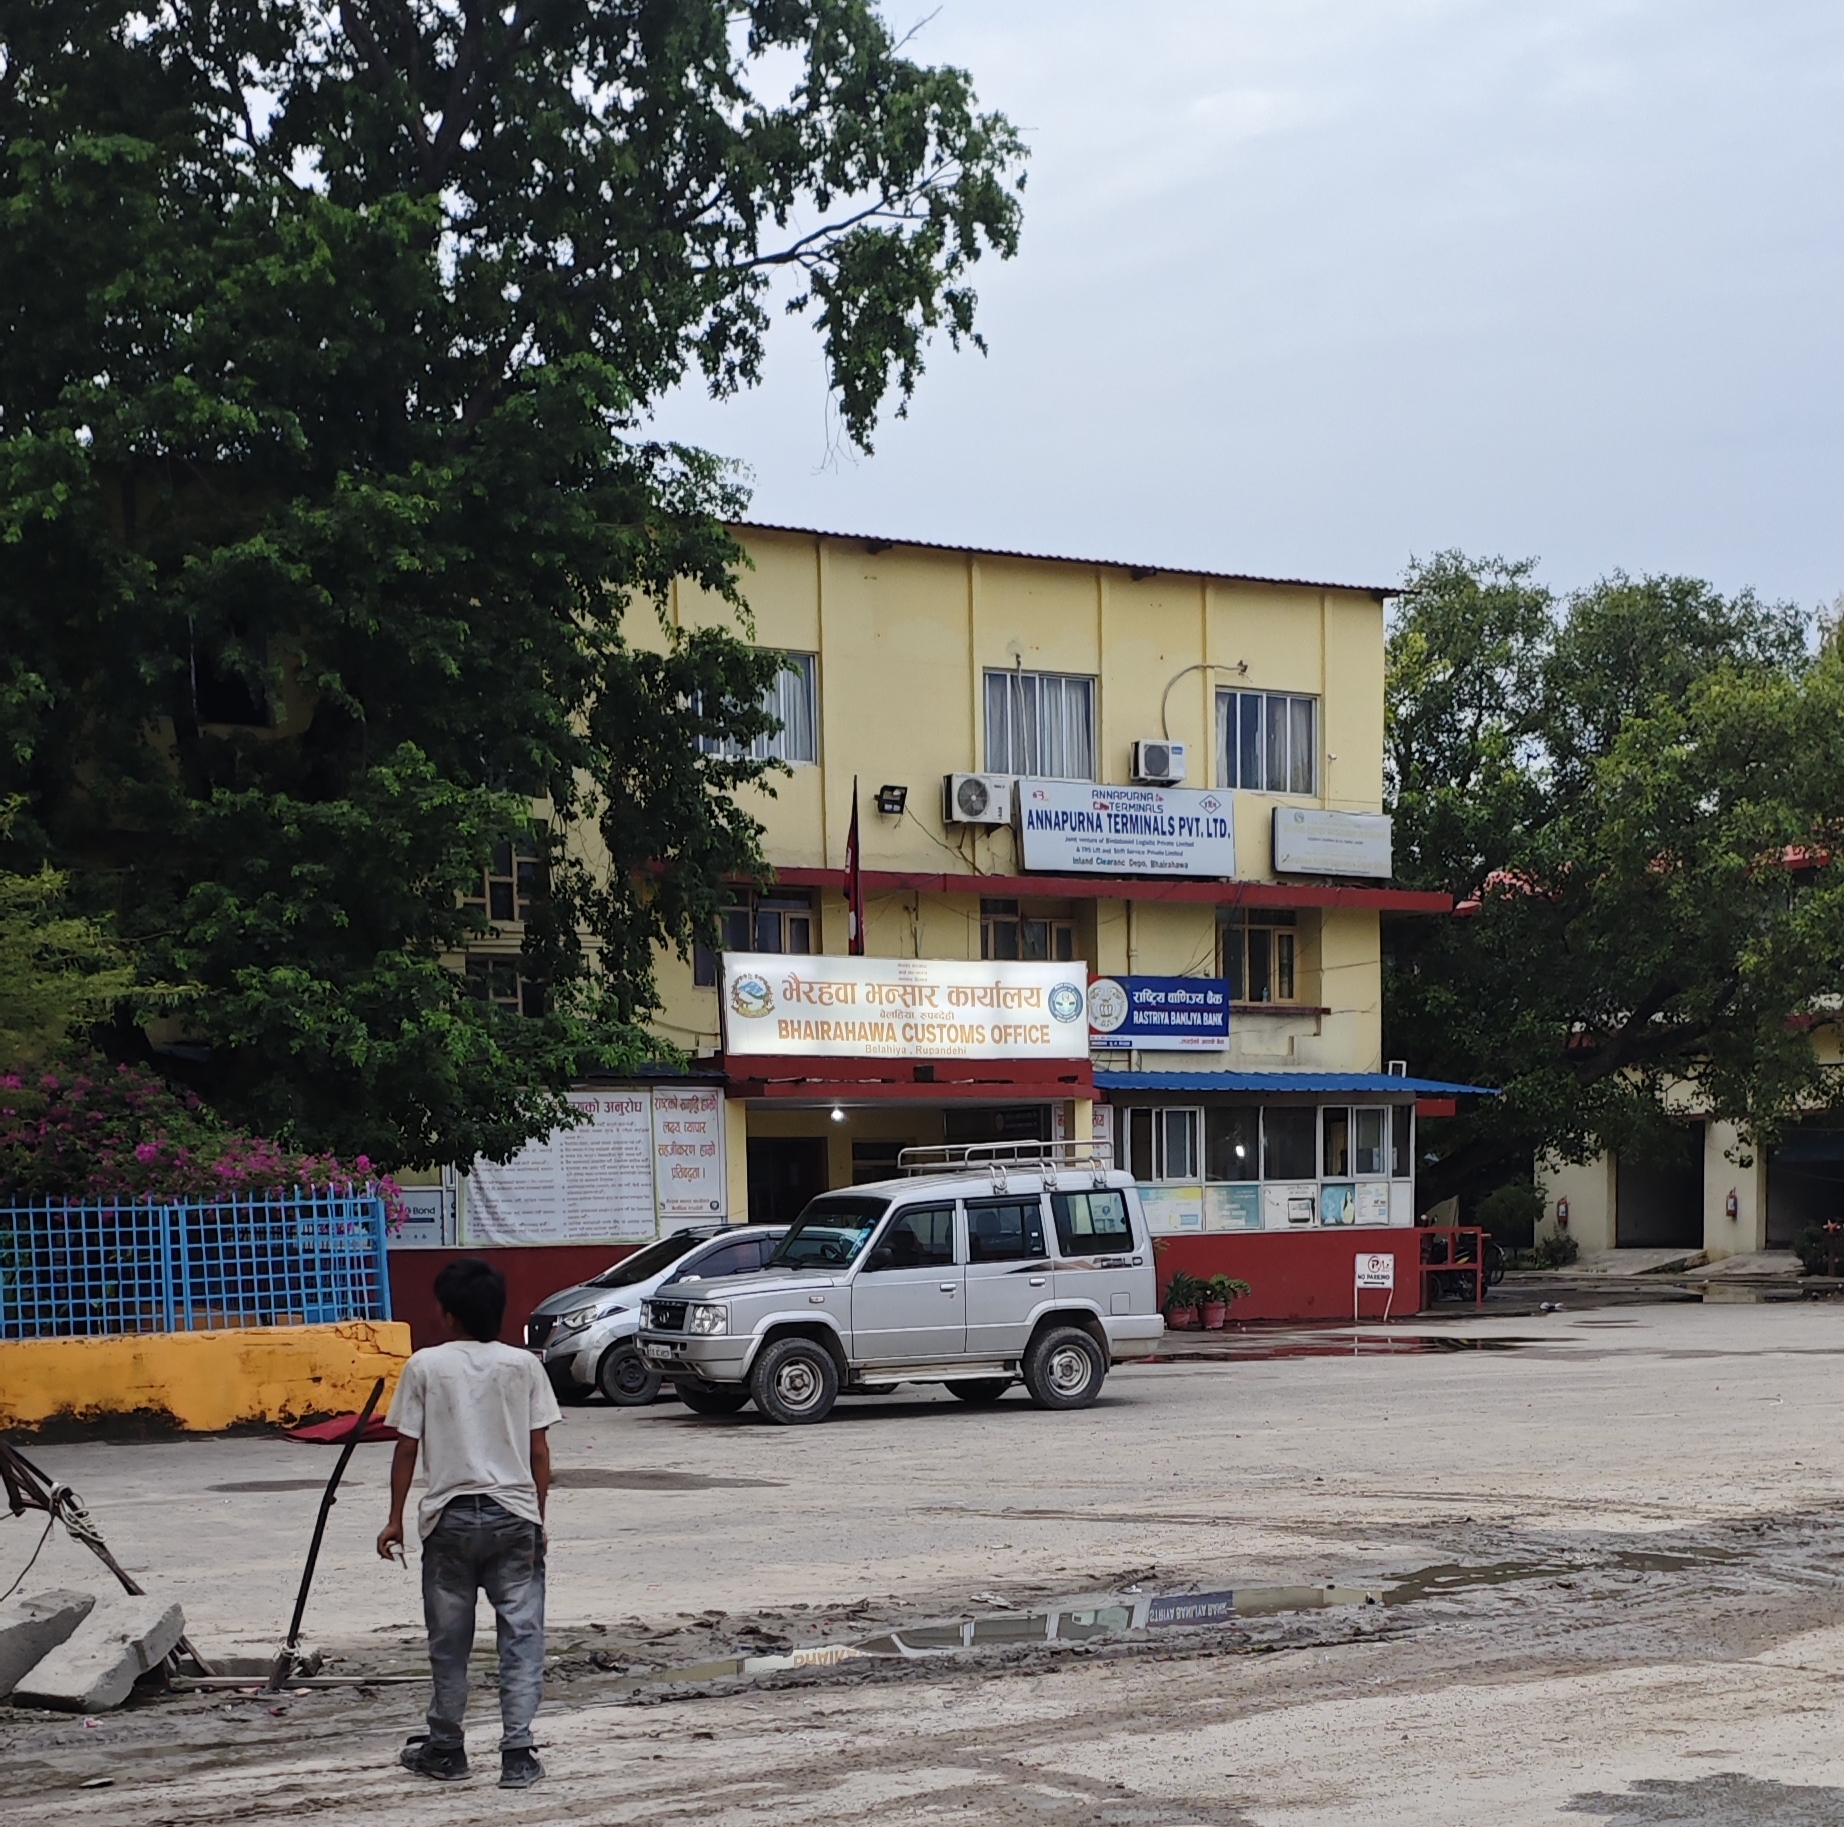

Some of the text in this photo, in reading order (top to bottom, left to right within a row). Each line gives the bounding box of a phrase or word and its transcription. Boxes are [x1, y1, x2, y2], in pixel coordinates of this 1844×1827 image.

[1092, 790, 1153, 802] ANNAPURNA
[1108, 802, 1164, 814] TERMINALS
[1027, 809, 1104, 834] ANNAPURNA
[1107, 813, 1176, 837] TERMINALS
[1179, 816, 1203, 839] PVT.
[1206, 817, 1231, 840] LTD.
[782, 971, 1042, 1009] भैरहवा भन्सार कार्यालय
[1133, 1011, 1223, 1027] RASTRIYA BANIJYA BANK
[778, 1019, 1050, 1044] BHAIRAHAWA CUSTOMS OFFICE
[915, 1045, 967, 1056] Rupandehi
[603, 1098, 642, 1116] अनुरोध
[413, 1207, 436, 1215] Bond
